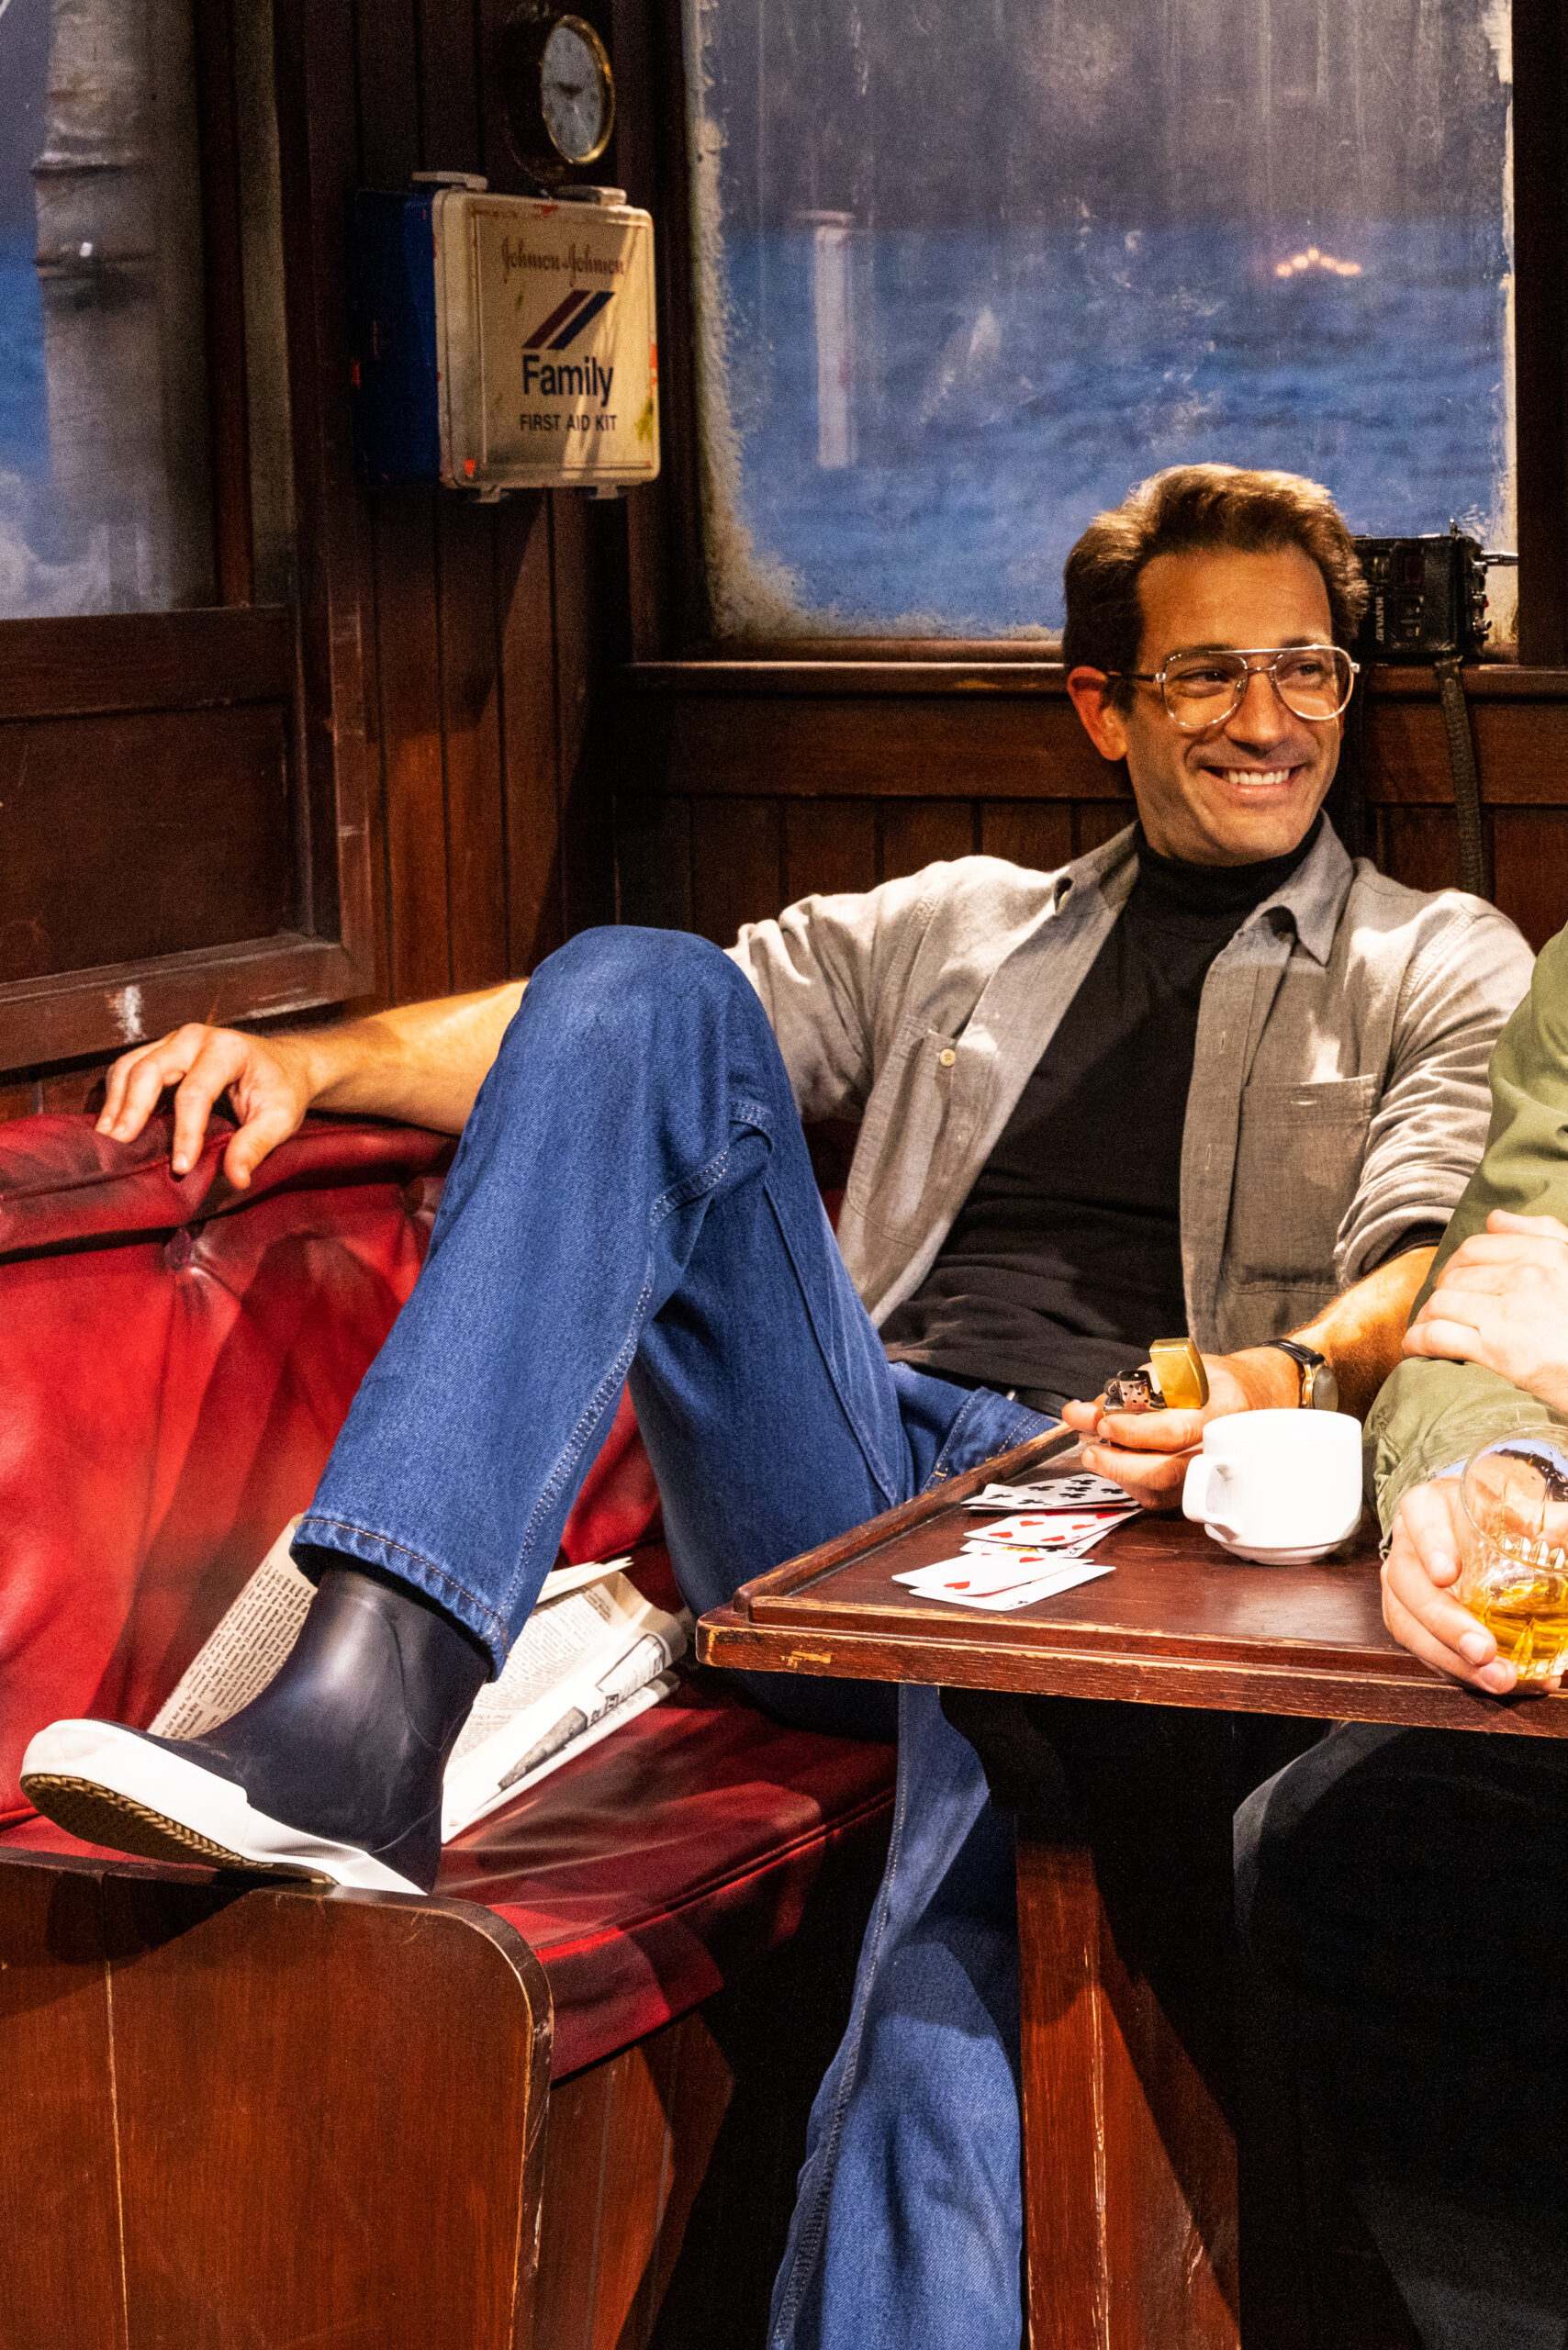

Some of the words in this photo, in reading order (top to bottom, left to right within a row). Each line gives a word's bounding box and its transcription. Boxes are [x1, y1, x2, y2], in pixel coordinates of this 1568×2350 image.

[501, 237, 560, 285] Johnson
[568, 242, 624, 288] Johnson
[522, 354, 614, 407] Family
[521, 414, 561, 431] FIRST
[566, 413, 590, 432] AID
[596, 414, 617, 432] KIT
